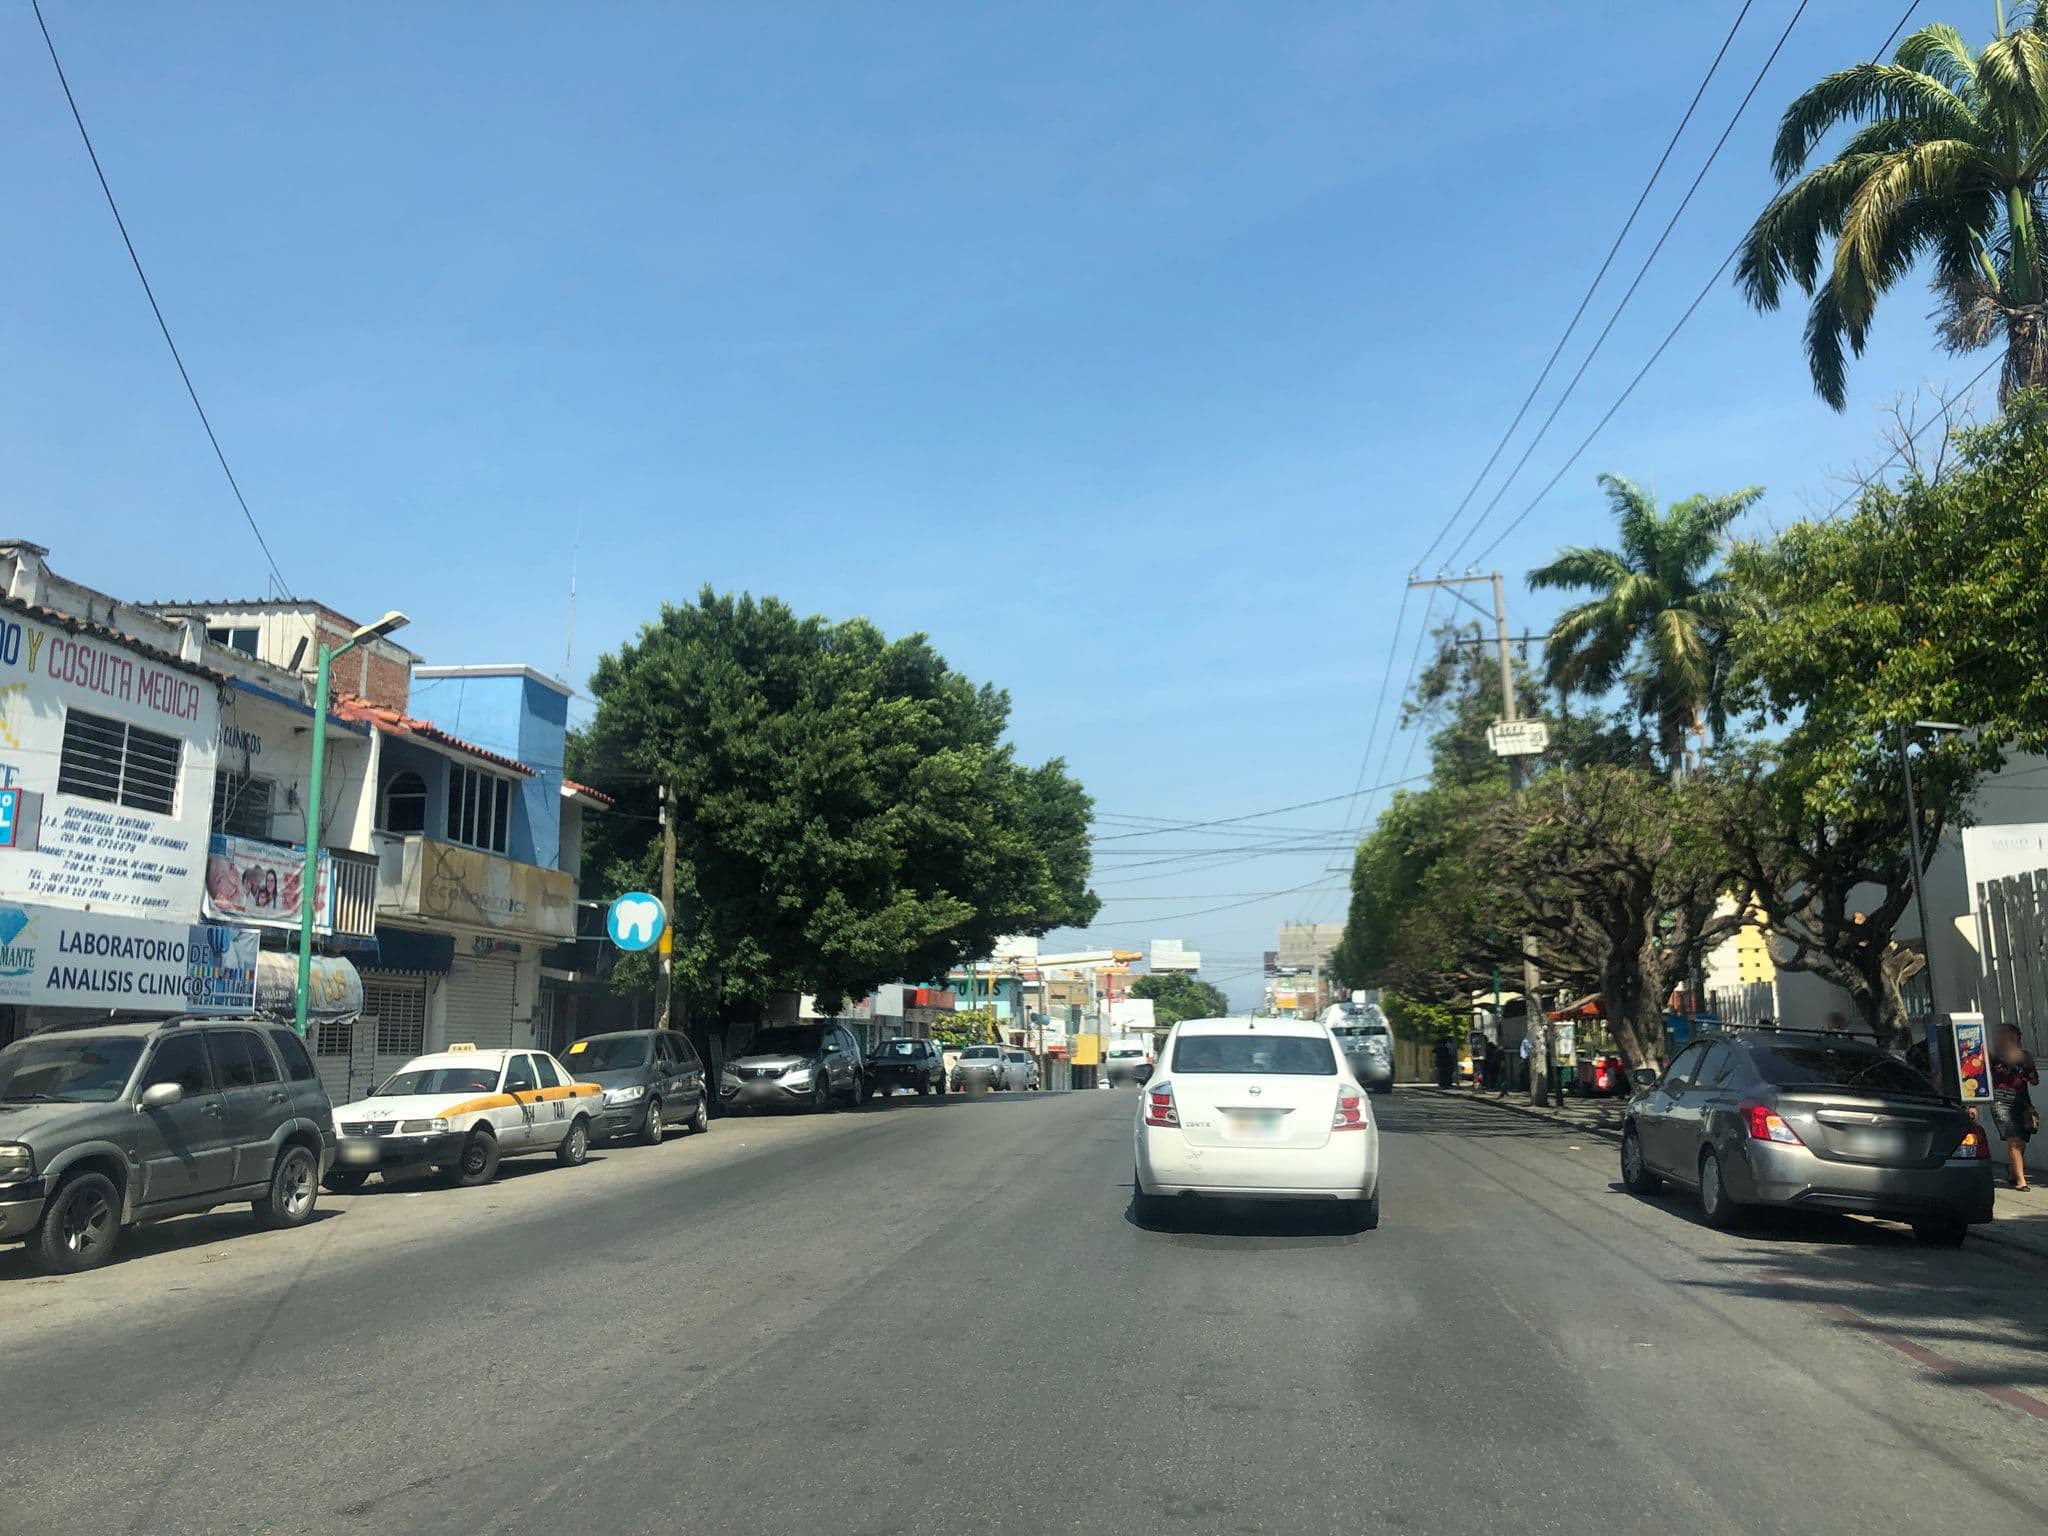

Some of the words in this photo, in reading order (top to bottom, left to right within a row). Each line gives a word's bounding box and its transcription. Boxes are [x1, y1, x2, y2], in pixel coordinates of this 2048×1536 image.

[28, 627, 44, 672] Y
[48, 637, 131, 702] COSULTA
[137, 666, 199, 721] MEDICA
[83, 823, 115, 837] ALFREDO
[59, 930, 185, 963] LABORATORIO
[190, 944, 209, 964] DE
[46, 966, 133, 993] ANALISIS
[138, 972, 212, 997] CLINICOS
